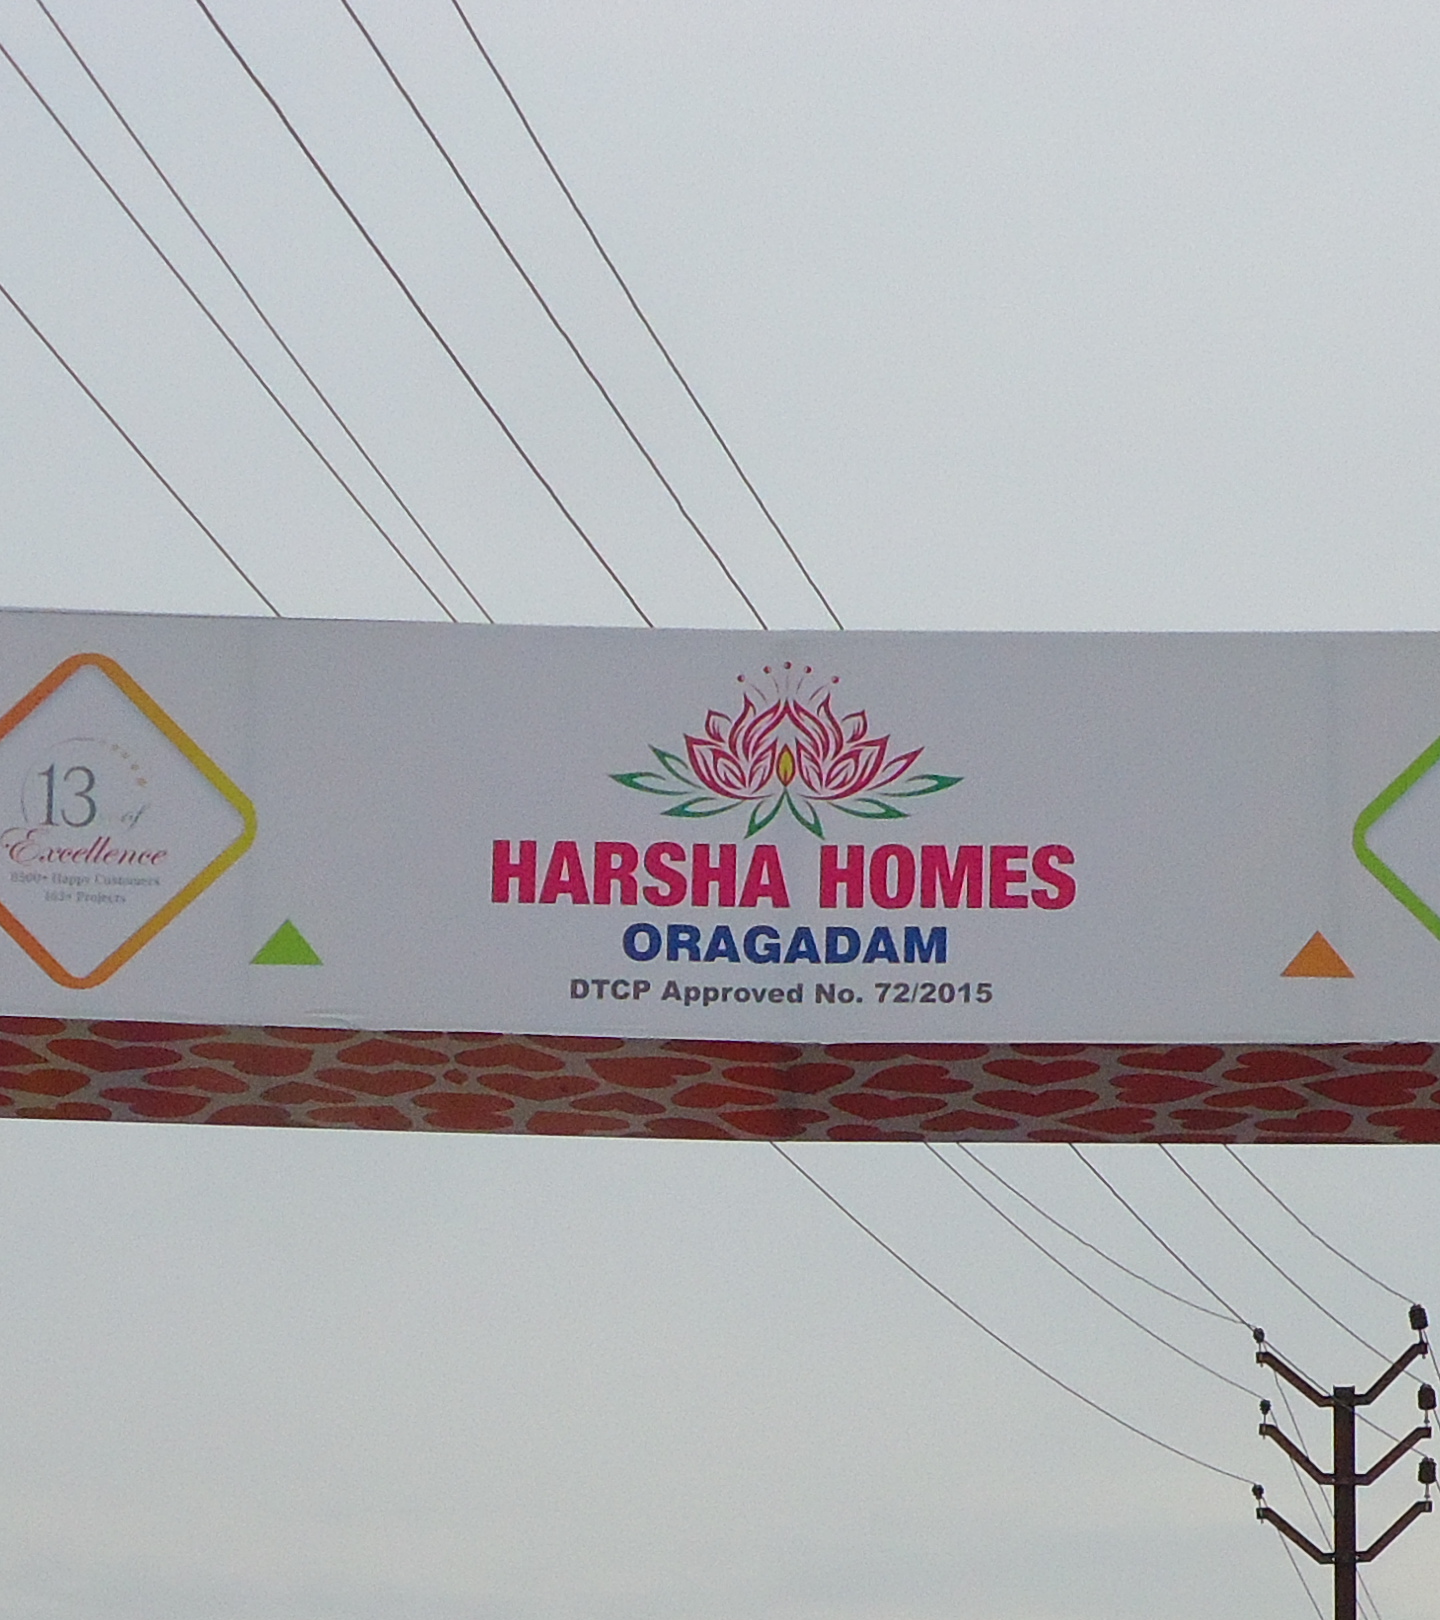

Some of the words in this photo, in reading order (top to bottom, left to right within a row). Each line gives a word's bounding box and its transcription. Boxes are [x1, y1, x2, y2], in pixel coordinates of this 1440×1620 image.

[38, 763, 97, 828] 13
[0, 827, 167, 867] Excellence
[491, 840, 791, 908] HARSHA
[820, 844, 1075, 910] HOMES
[622, 922, 948, 964] ORAGADAM
[570, 978, 651, 1000] DTCP
[661, 981, 804, 1007] Approved
[814, 983, 863, 1004] No.
[875, 982, 993, 1004] 72/2015
